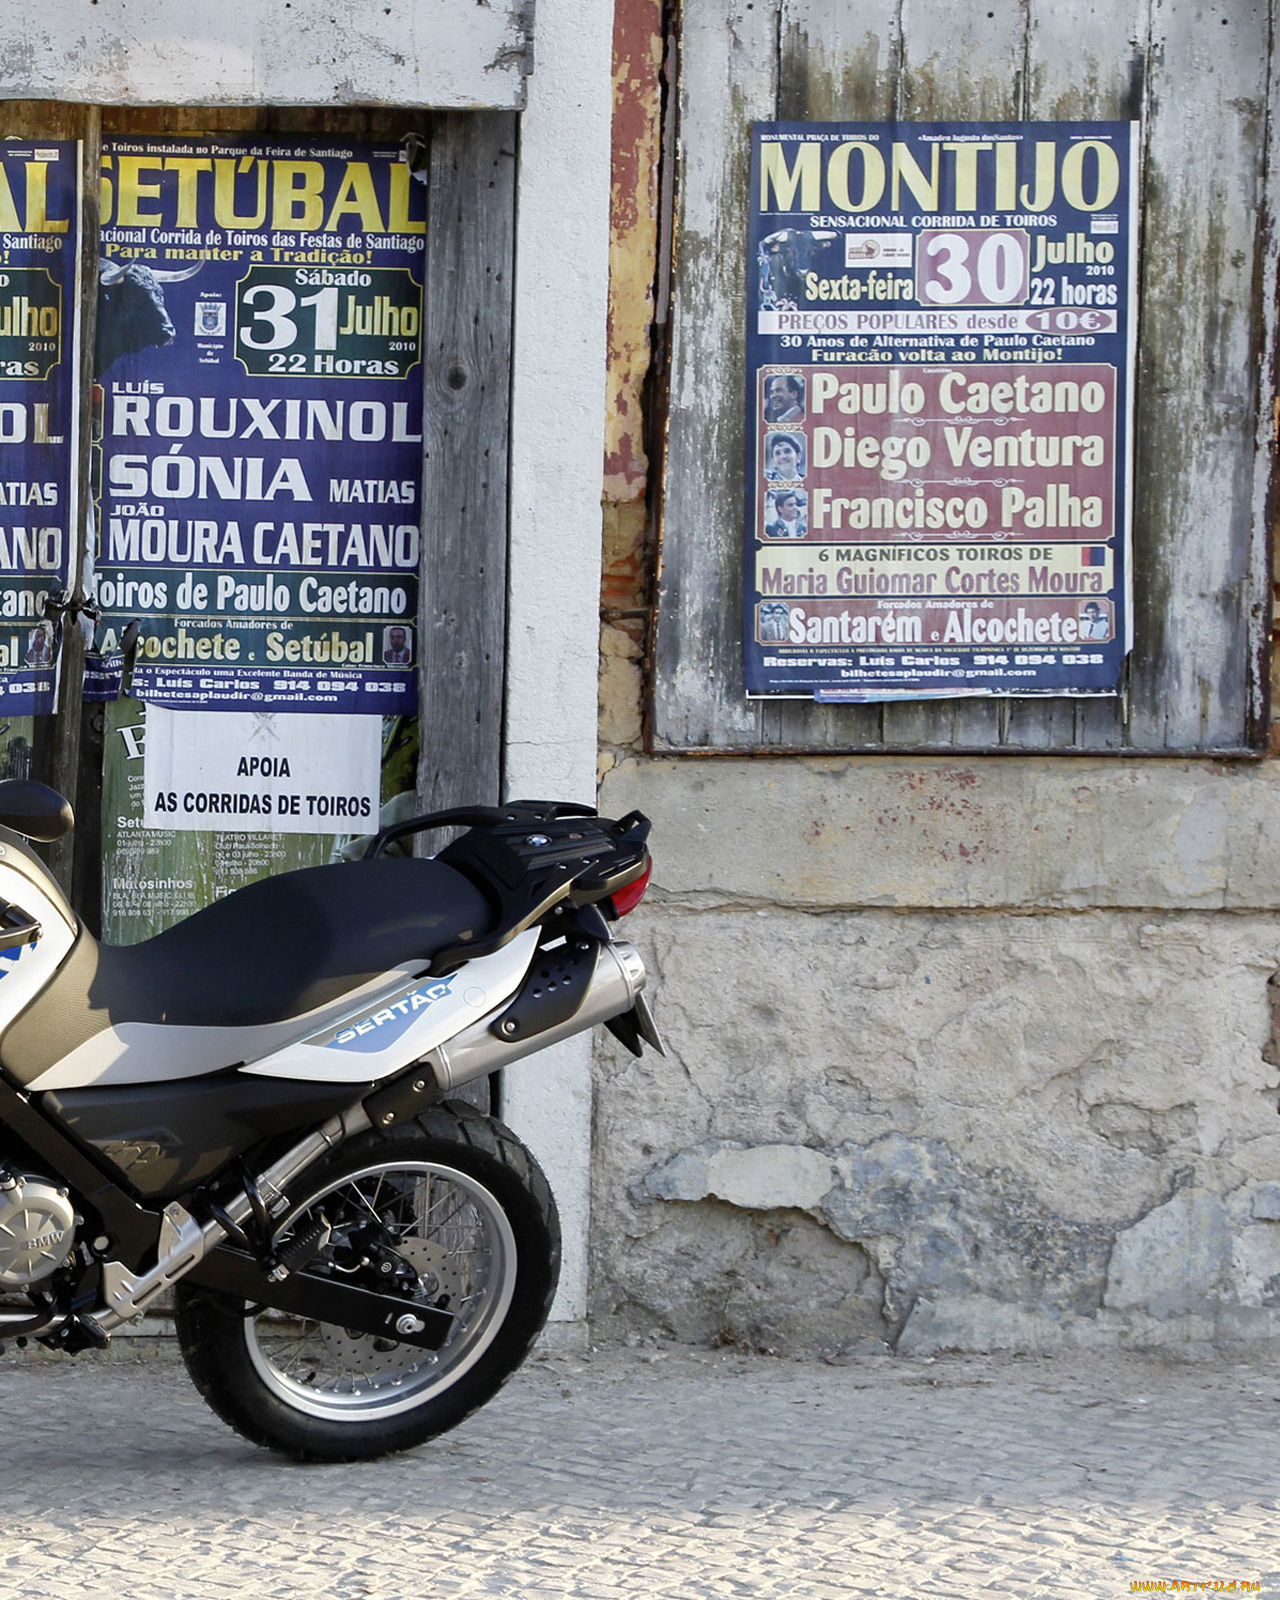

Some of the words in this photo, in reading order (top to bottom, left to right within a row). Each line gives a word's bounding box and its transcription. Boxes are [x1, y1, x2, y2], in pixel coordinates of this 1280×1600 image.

[760, 141, 1120, 212] MONTIJO
[810, 215, 908, 228] SENSACIONAL
[911, 215, 977, 228] CORRIDA
[980, 214, 1001, 227] DE
[1004, 214, 1057, 227] TOIROS
[1032, 233, 1114, 272] Julho
[295, 269, 372, 287] Sábado
[925, 233, 1024, 304] 30
[1086, 265, 1114, 276] 2010
[805, 271, 913, 301] Sexta-feira
[1031, 277, 1057, 305] 22
[1062, 275, 1117, 306] horas
[239, 284, 339, 351] 31
[340, 295, 418, 336] Julho
[778, 313, 848, 332] PREÇOS
[857, 313, 958, 330] POPULARES
[967, 313, 1018, 330] desde
[1034, 311, 1101, 330] 10€
[28, 342, 55, 352] 2010
[389, 342, 416, 351] 2010
[811, 349, 892, 362] Furacão
[897, 348, 947, 362] volta
[952, 350, 976, 362] ao
[983, 347, 1063, 363] Montijo!
[268, 354, 306, 373] 22
[314, 354, 400, 375] Horas
[112, 380, 165, 394] LUÍS
[811, 369, 925, 415] Paulo
[939, 371, 1105, 415] Caetano
[112, 395, 423, 442] ROUXINOL
[812, 427, 931, 481] Diego
[944, 427, 1105, 468] Ventura
[109, 443, 313, 501] SÓNIA
[329, 479, 415, 504] MATIAS
[110, 502, 165, 517] JOÃO
[812, 486, 987, 529] Francisco
[1001, 484, 1103, 528] Palha
[108, 519, 245, 564] MOURA
[253, 521, 420, 568] CAETANO
[819, 548, 828, 562] 6
[835, 546, 950, 562] MAGNÍFICOS
[958, 547, 1023, 561] TOIROS
[1029, 547, 1053, 561] DE
[761, 567, 828, 595] Maria
[837, 567, 937, 595] Guiomar
[945, 566, 1019, 594] Cortes
[1028, 566, 1103, 593] Moura
[789, 607, 921, 643] Santarém
[931, 630, 940, 643] e
[944, 607, 1078, 643] Alcochete
[237, 757, 291, 778] APOIA
[155, 792, 177, 812] AS
[183, 792, 272, 814] CORRIDAS
[278, 795, 300, 815] DE
[306, 796, 371, 817] TOIROS
[113, 878, 193, 890] Matosinhos
[334, 982, 451, 1044] SERTÃO
[28, 1230, 64, 1250] BMW
